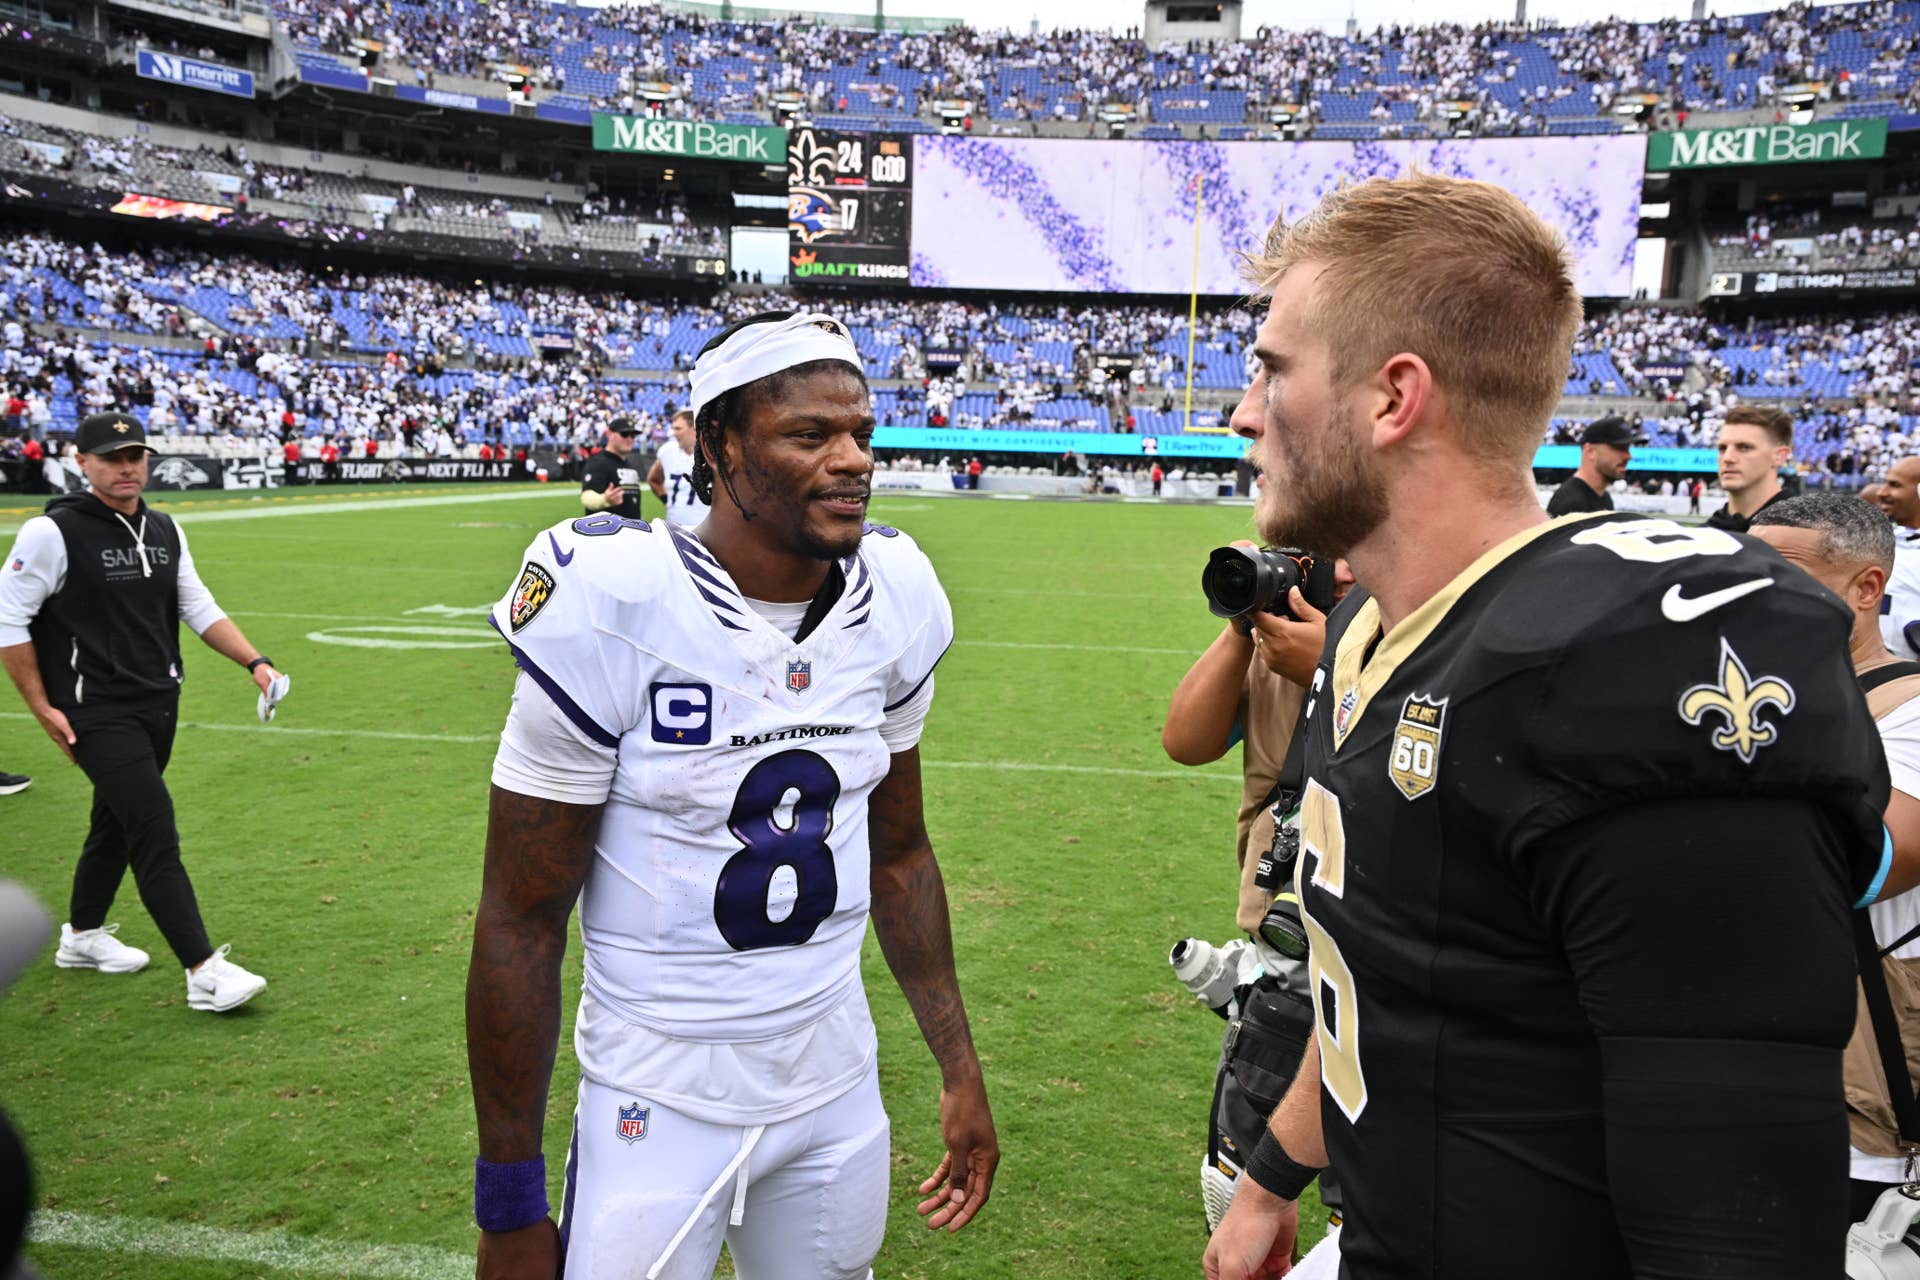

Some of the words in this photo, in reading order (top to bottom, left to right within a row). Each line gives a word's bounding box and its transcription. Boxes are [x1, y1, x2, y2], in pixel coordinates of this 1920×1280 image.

[185, 63, 240, 86] merritt
[611, 116, 693, 153] M&T
[695, 123, 768, 159] Bank
[1669, 126, 1767, 166] M&T
[1767, 122, 1862, 160] Bank
[837, 140, 862, 173] 24
[872, 154, 906, 182] 0:00
[840, 198, 859, 230] 17
[795, 262, 909, 279] DRAFTKINGS
[427, 463, 460, 478] NEXT
[462, 463, 512, 478] FLIT
[527, 564, 554, 588] RAVENS
[791, 673, 808, 688] NFL
[655, 687, 707, 729] C
[730, 726, 855, 747] BALTIMORE
[1394, 736, 1435, 779] 60
[713, 749, 841, 951] 8
[621, 1120, 643, 1136] NFL
